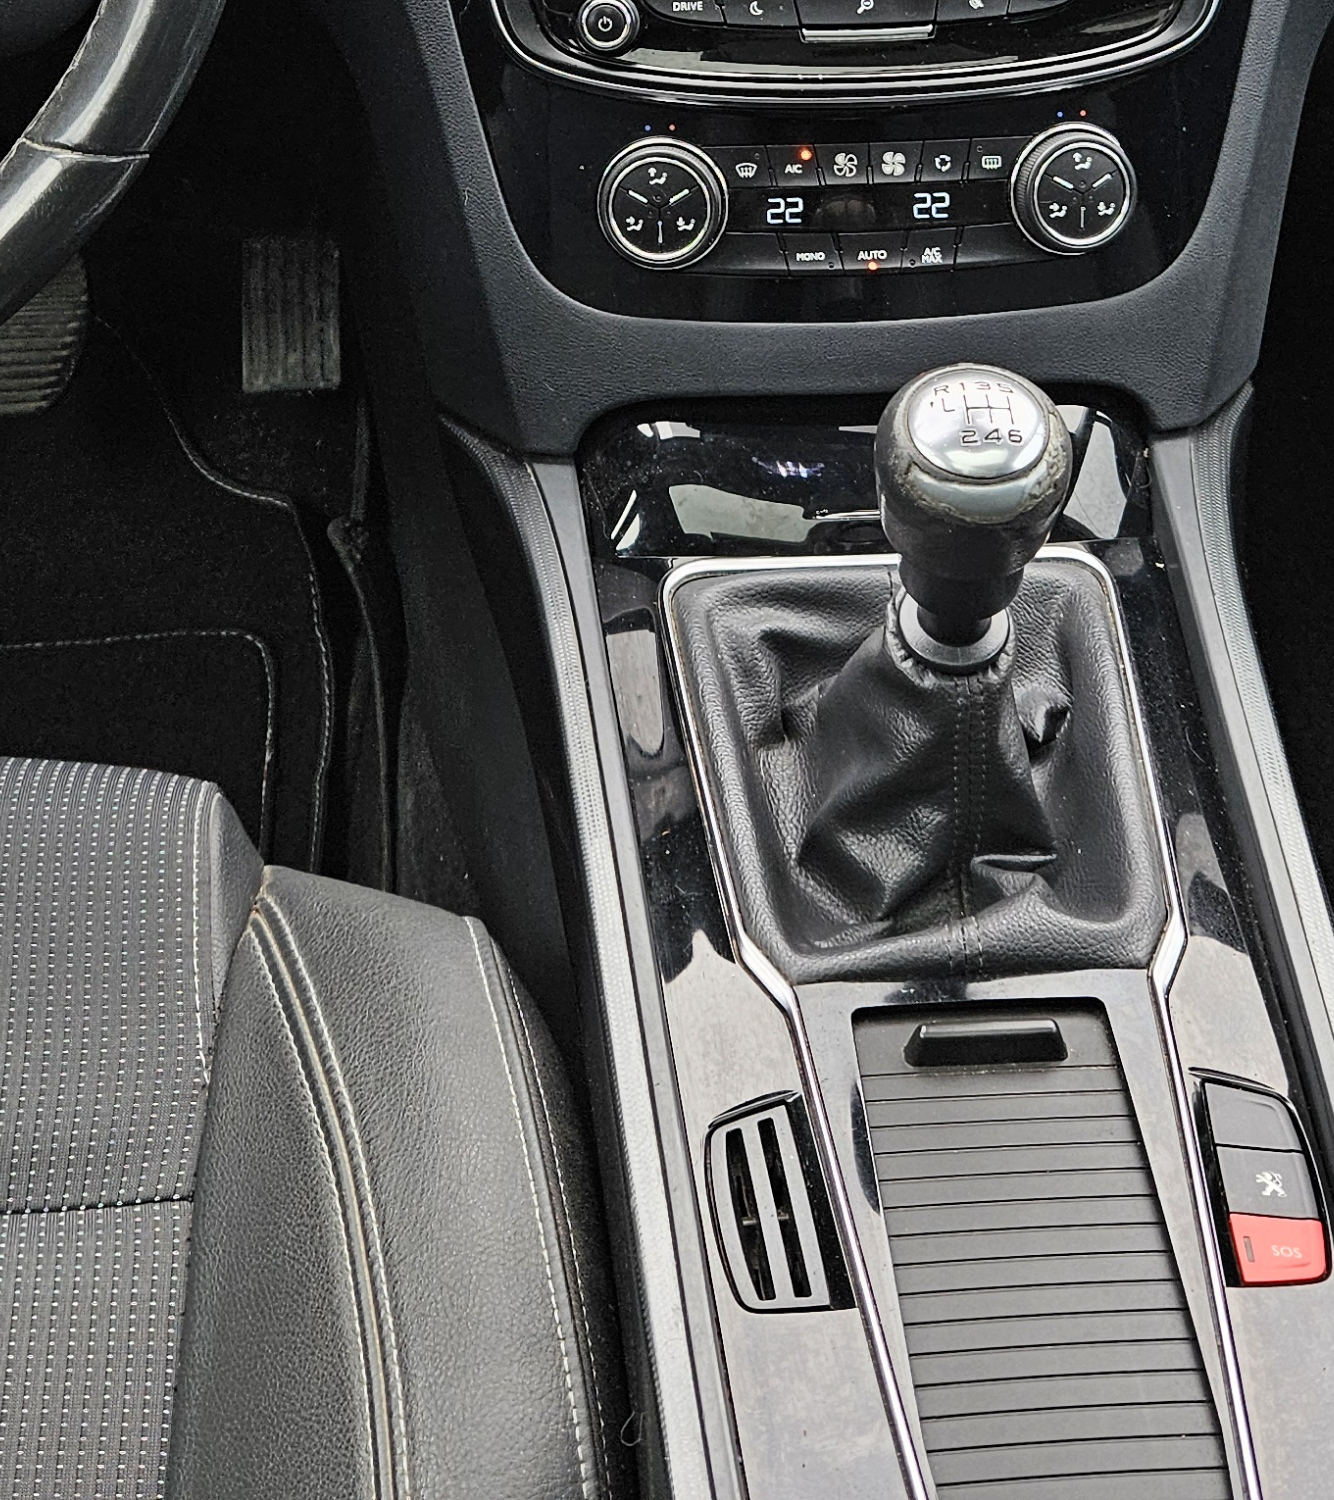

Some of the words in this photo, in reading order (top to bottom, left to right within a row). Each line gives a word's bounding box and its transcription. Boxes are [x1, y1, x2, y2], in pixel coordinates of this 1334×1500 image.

[672, 1, 704, 12] DRIVE
[784, 164, 803, 174] A/C
[767, 197, 804, 224] 22
[913, 192, 951, 219] 22
[796, 252, 826, 262] MONO
[857, 250, 888, 261] AUTO
[921, 255, 943, 264] MAX
[933, 384, 950, 397] R
[974, 380, 992, 391] 3
[960, 429, 979, 444] 2
[984, 428, 1002, 443] 4
[1007, 429, 1024, 444] 6
[1270, 1244, 1303, 1260] SOS
